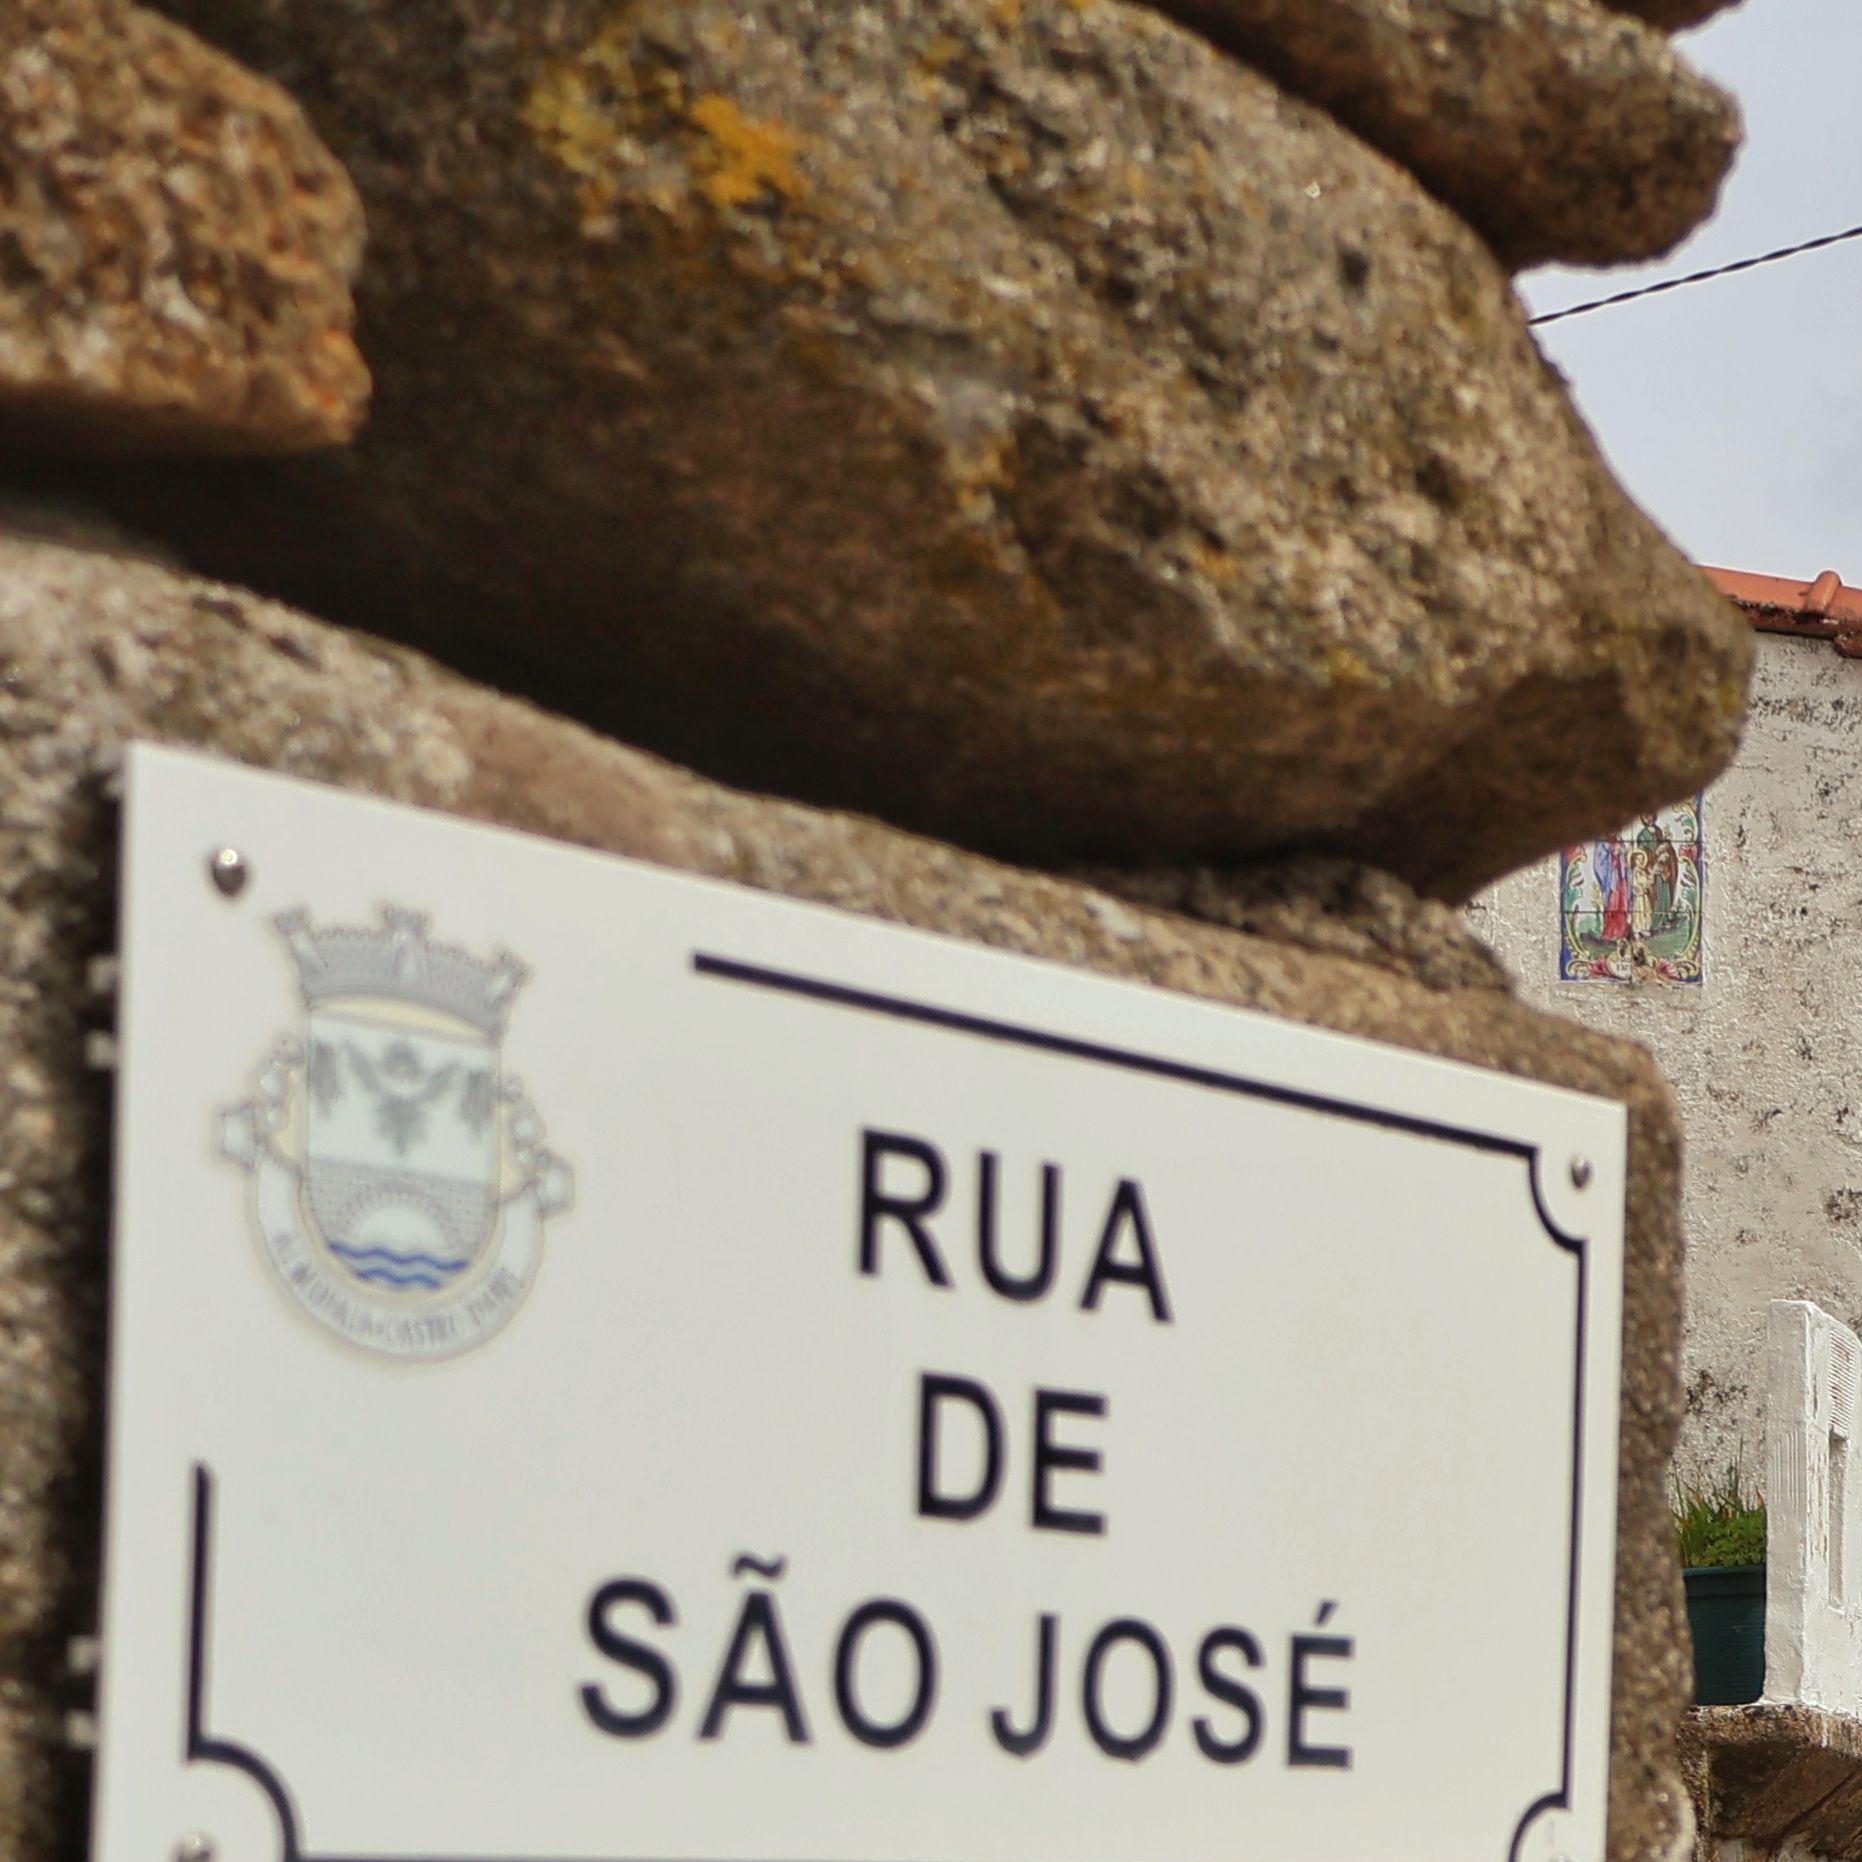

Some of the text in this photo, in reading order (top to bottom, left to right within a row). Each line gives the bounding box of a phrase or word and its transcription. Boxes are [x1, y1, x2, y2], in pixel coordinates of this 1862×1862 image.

[855, 1127, 1175, 1326] RUA
[915, 1370, 1109, 1537] DE
[579, 1553, 1355, 1771] SÃO JOSÉ
